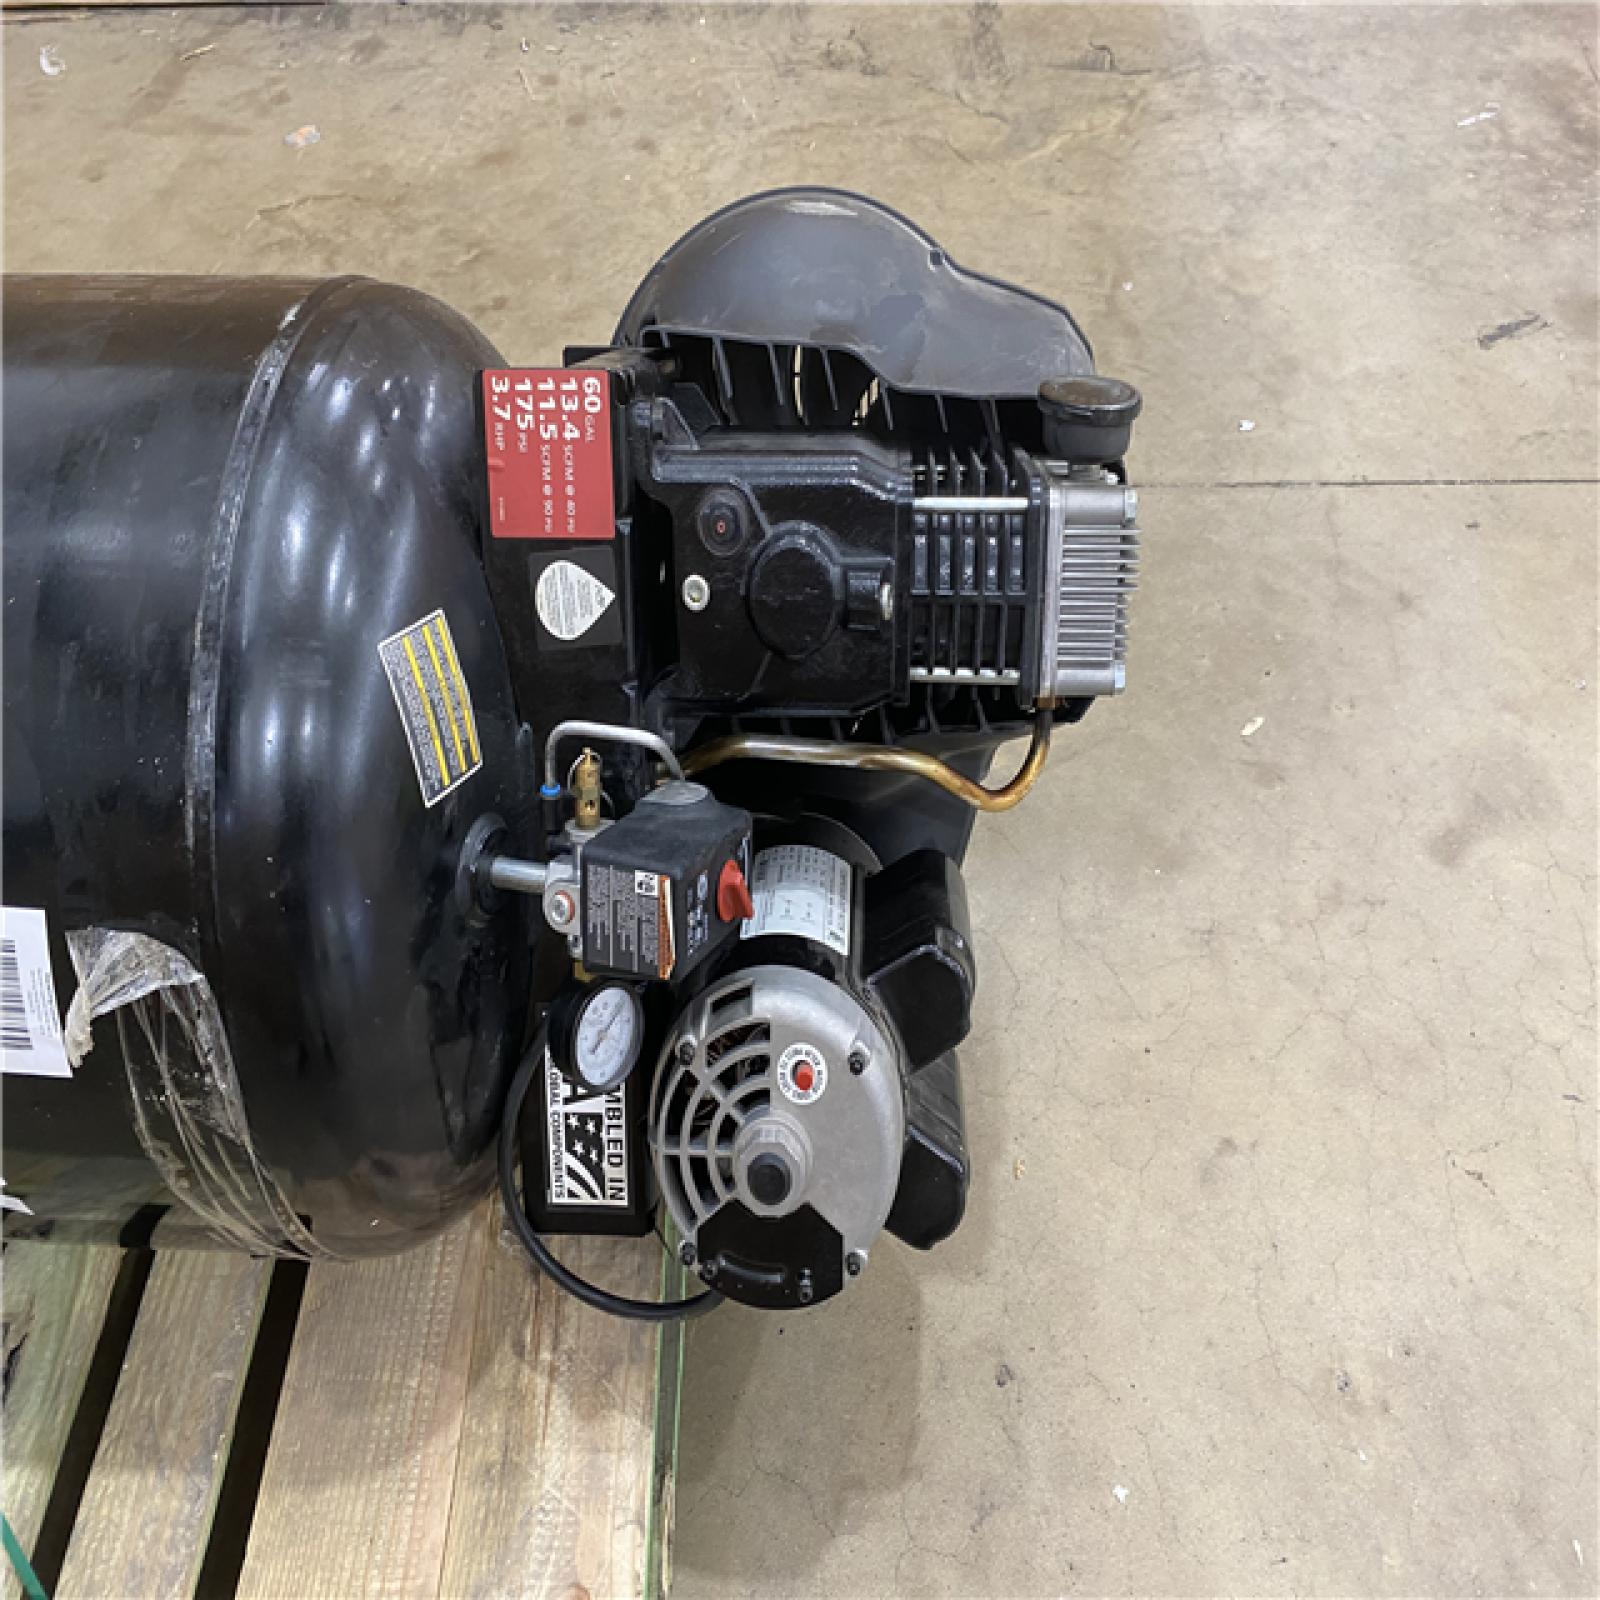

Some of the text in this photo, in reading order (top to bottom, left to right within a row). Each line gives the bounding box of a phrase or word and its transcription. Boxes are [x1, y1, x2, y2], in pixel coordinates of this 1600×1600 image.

[491, 376, 511, 420] 3.7
[514, 377, 535, 453] 175 PSI
[537, 377, 558, 440] 11.5
[560, 377, 581, 440] 13.4
[584, 377, 601, 442] 60 GAL
[541, 444, 551, 480] SCFM
[543, 485, 553, 496] @
[564, 444, 574, 480] SCFM
[565, 485, 575, 496] @
[550, 1112, 564, 1199] COMPONENTS
[606, 1084, 625, 1200] MBLED IN
